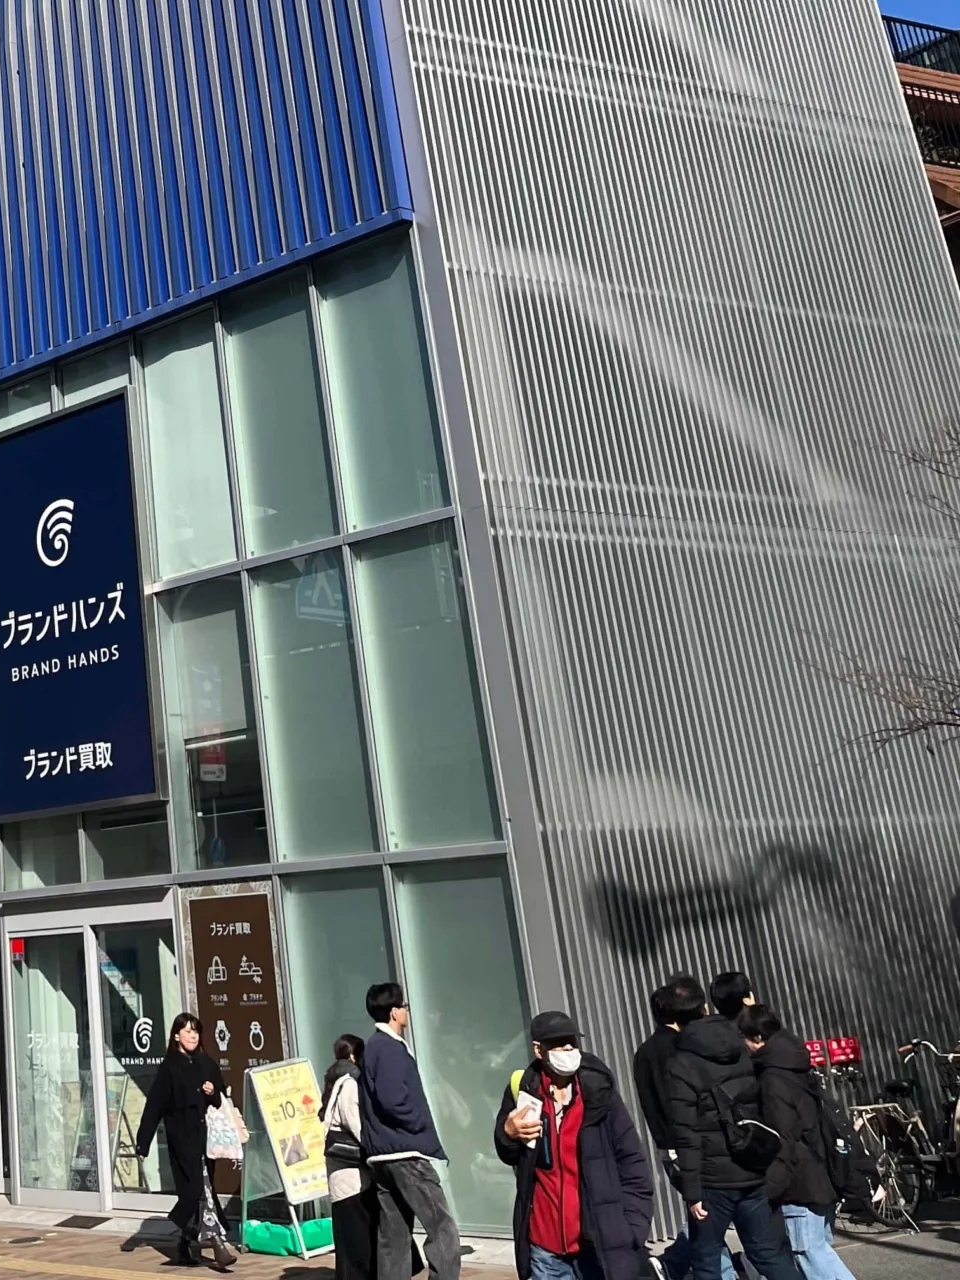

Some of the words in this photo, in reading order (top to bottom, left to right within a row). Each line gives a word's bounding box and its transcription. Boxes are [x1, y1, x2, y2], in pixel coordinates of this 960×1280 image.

[1, 582, 126, 649] ブランドハンズ
[11, 658, 61, 682] BRAND
[68, 644, 120, 670] HANDS
[24, 741, 114, 780] ブランド買取
[209, 922, 251, 936] ブランド買取
[121, 1057, 144, 1065] BRAND
